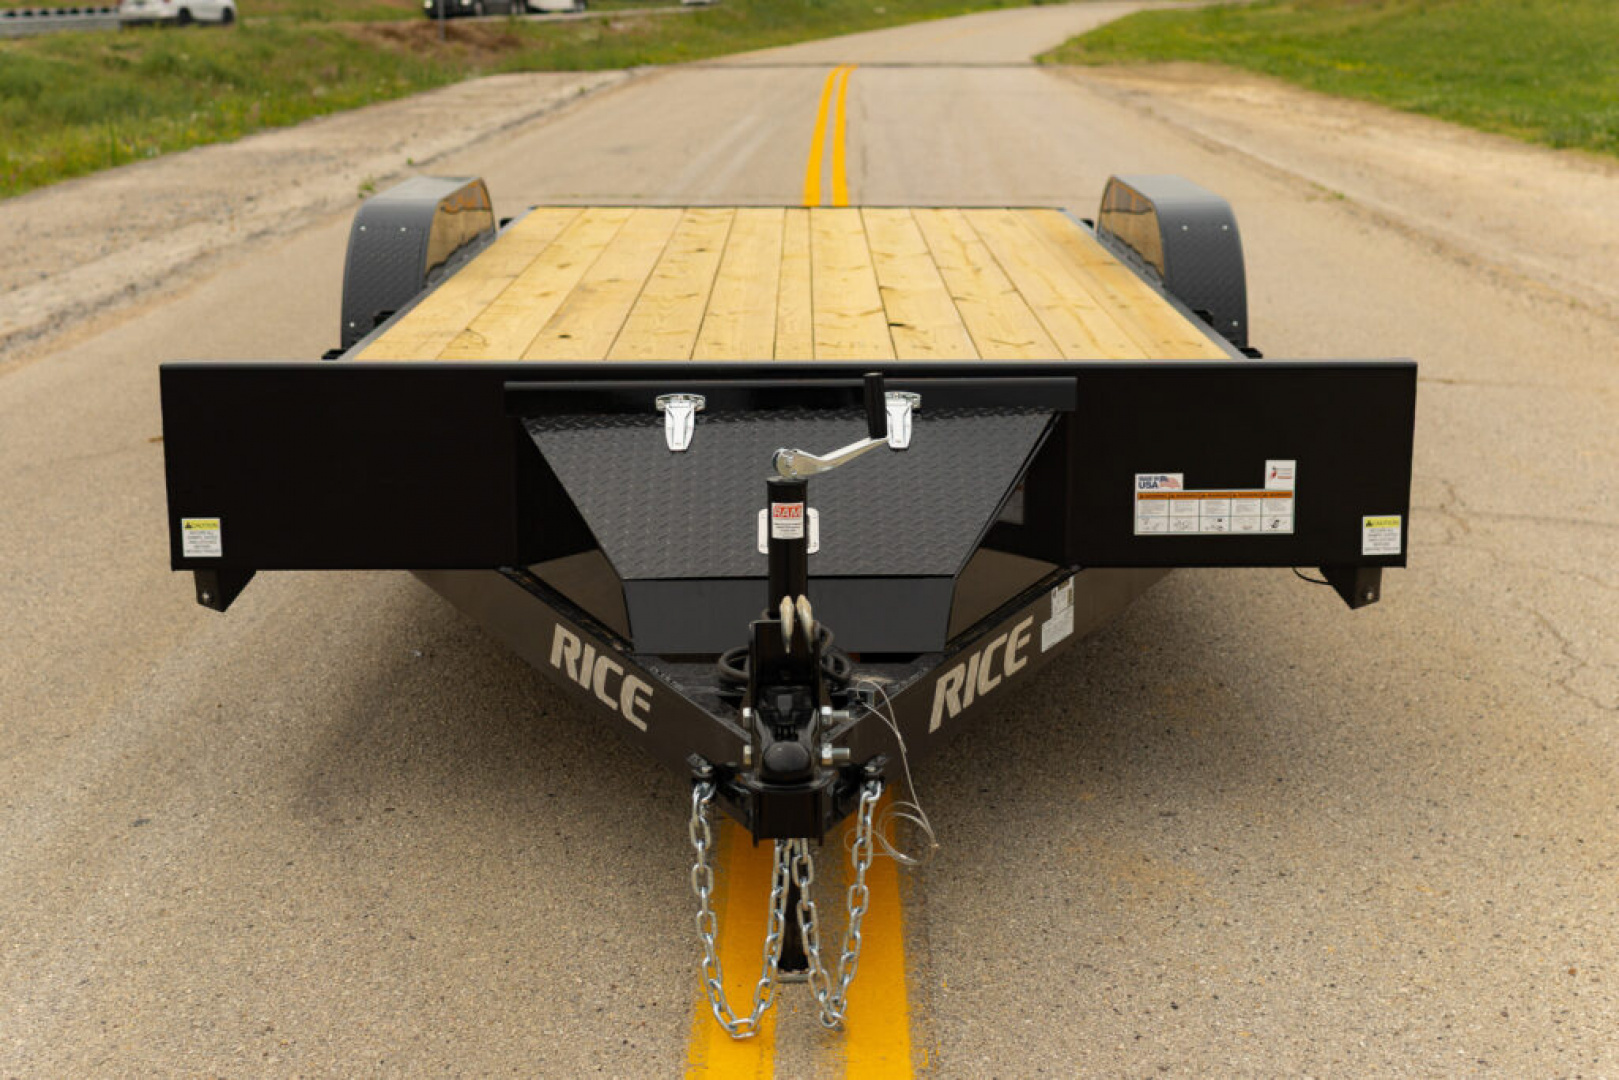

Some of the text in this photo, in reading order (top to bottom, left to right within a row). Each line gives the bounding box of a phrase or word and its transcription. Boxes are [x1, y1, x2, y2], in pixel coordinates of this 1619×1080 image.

[1138, 481, 1158, 489] USA
[550, 622, 654, 732] RICE
[929, 615, 1034, 734] RICE
